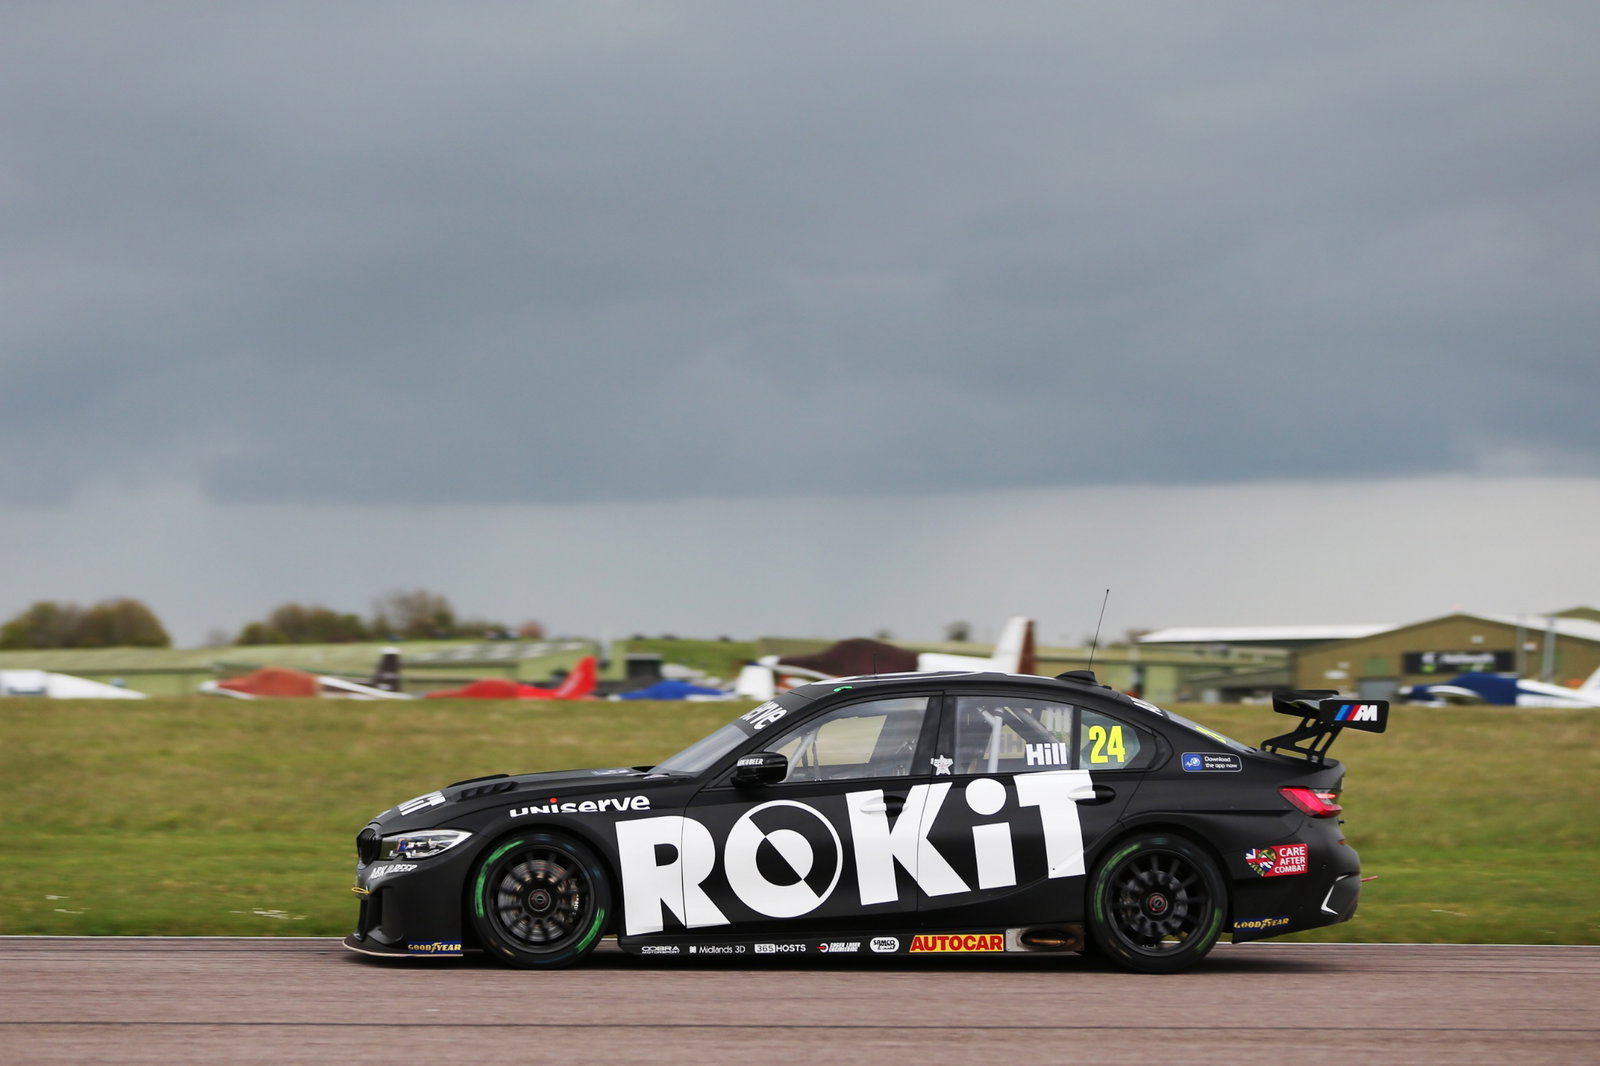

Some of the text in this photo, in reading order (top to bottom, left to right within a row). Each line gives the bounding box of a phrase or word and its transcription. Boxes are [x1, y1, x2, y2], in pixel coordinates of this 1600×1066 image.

[1352, 704, 1378, 721] M
[1089, 725, 1126, 764] 24
[1025, 743, 1068, 766] Hill
[509, 795, 651, 818] uniserve
[1279, 846, 1305, 857] CARE
[1280, 857, 1306, 866] AFTER
[1274, 864, 1306, 874] COMBAT
[1233, 918, 1289, 930] GOODYEAR
[407, 942, 462, 953] GOODYEAR
[910, 935, 1003, 951] AUTOCAR
[698, 945, 746, 954] Midlands 3D
